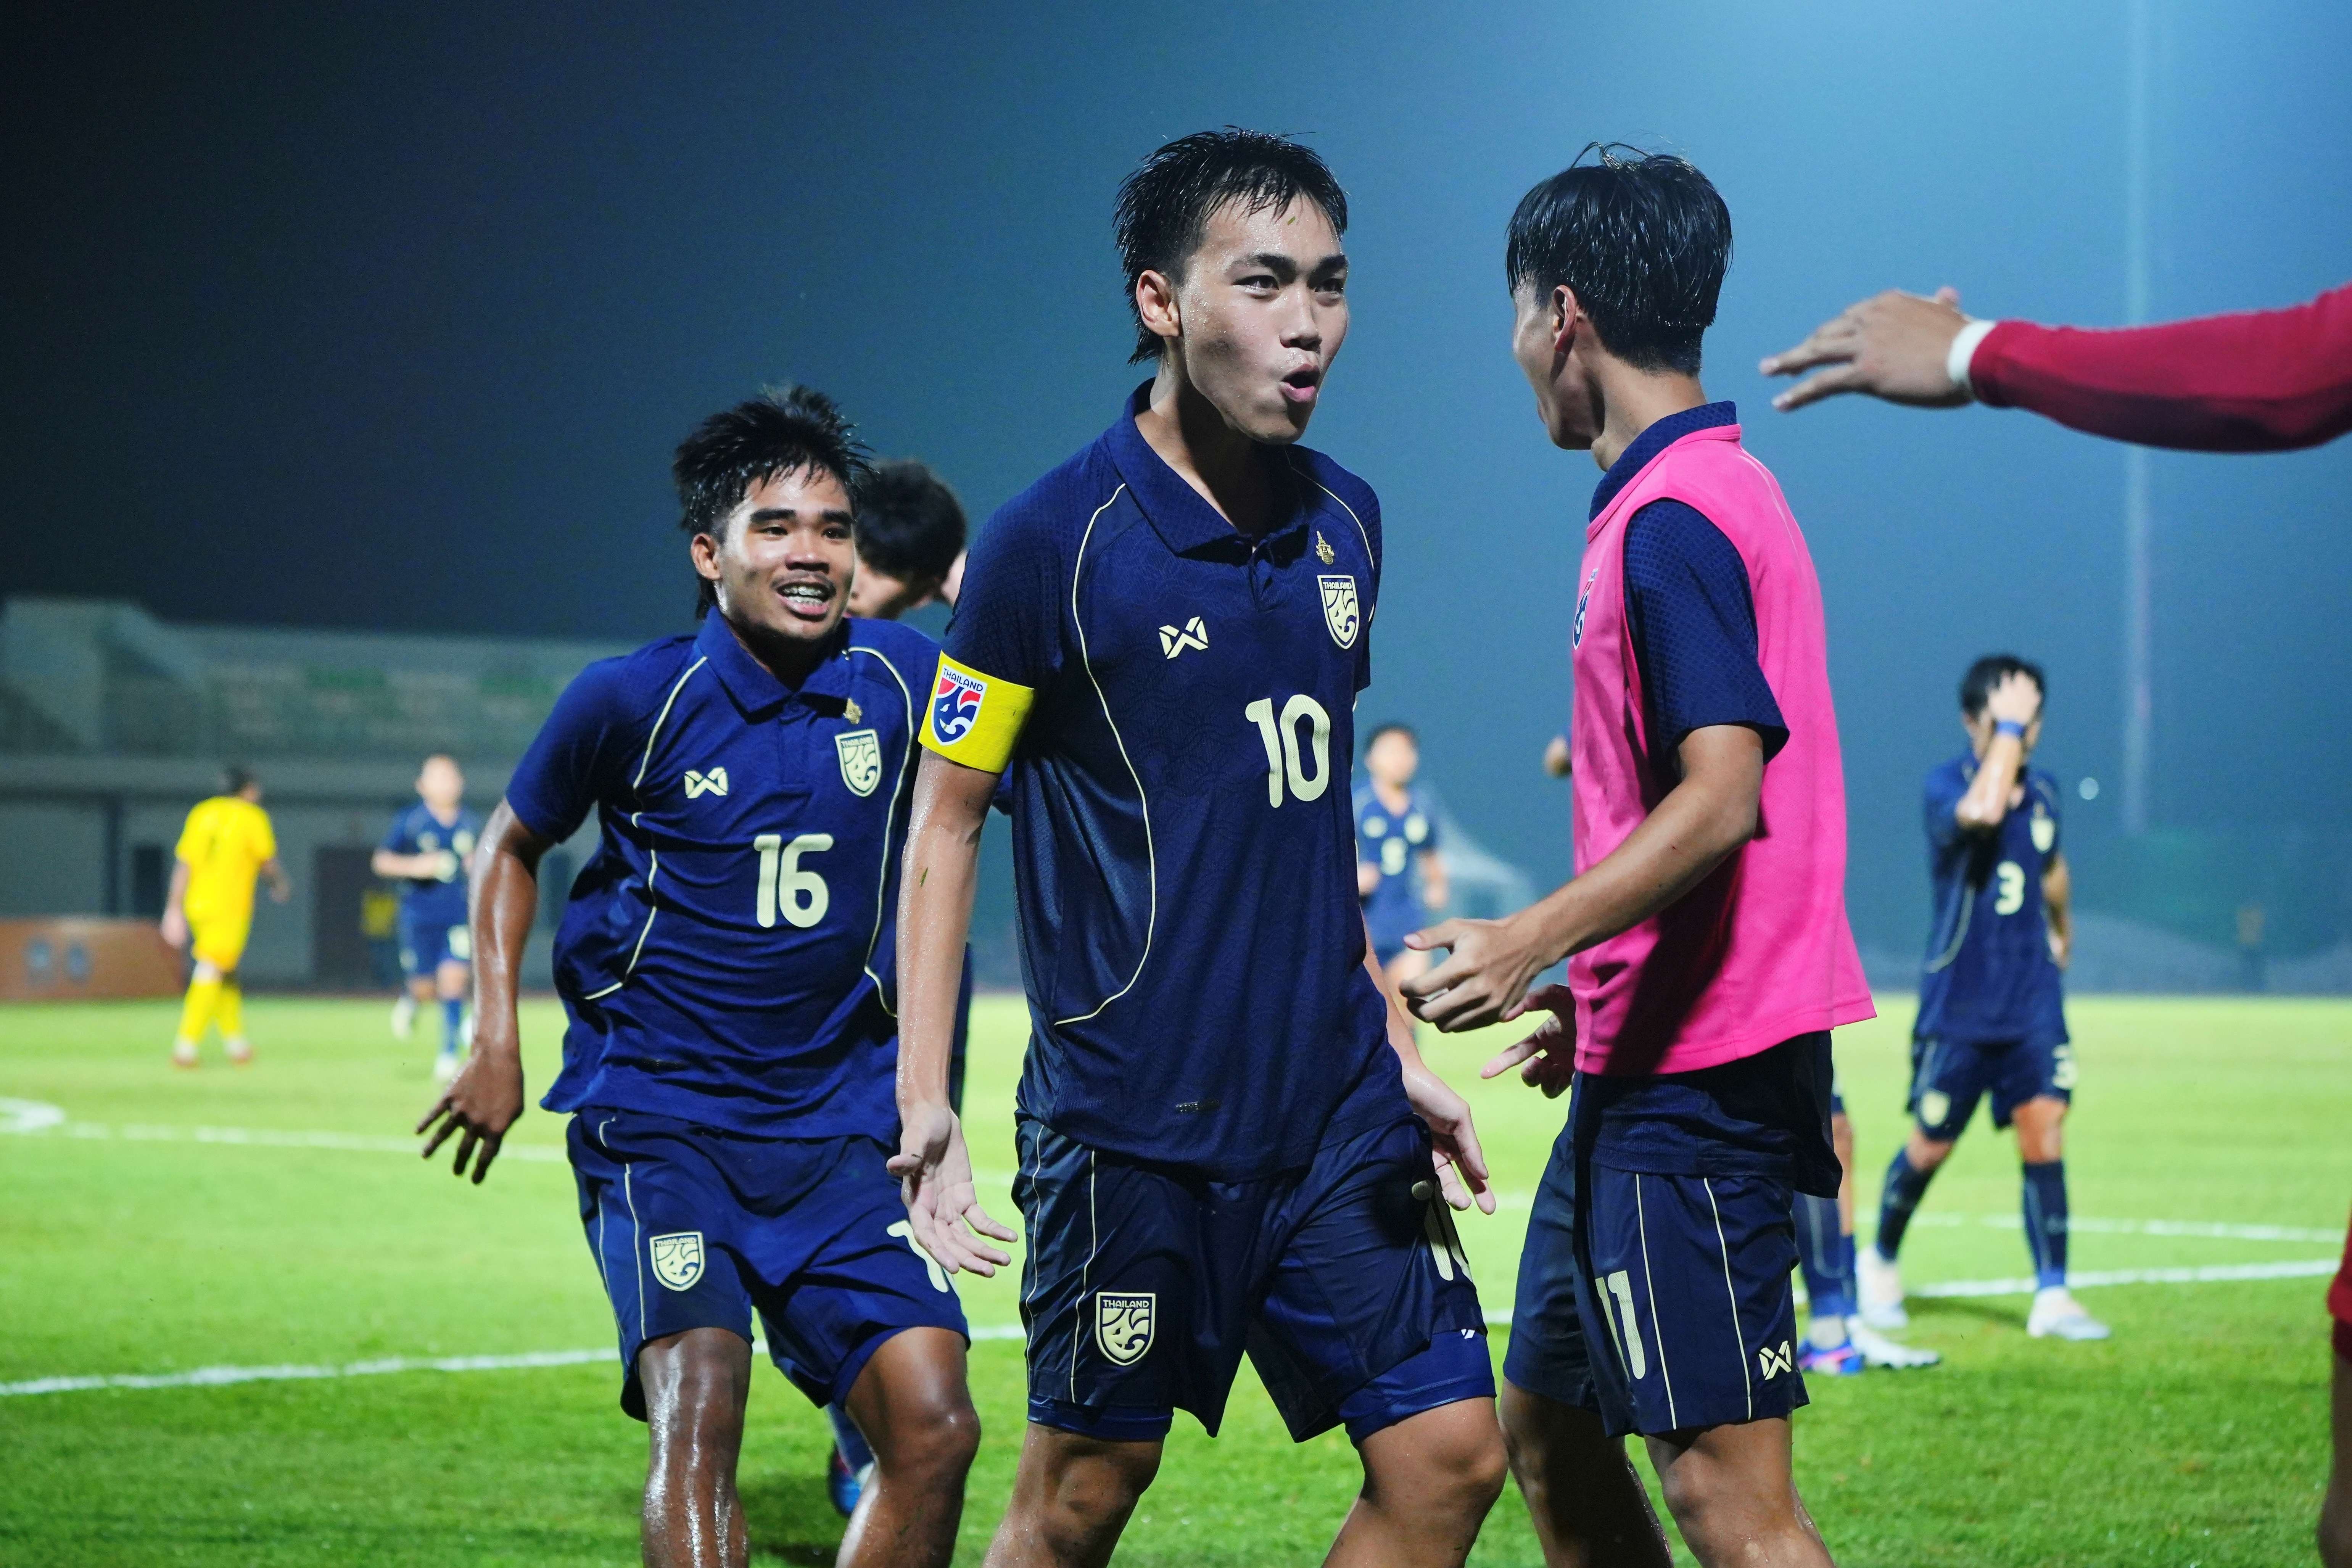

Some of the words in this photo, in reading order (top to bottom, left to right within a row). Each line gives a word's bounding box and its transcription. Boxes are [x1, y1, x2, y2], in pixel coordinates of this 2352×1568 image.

[1322, 581, 1352, 590] THAILAND
[943, 668, 984, 692] THAILAND
[1245, 694, 1331, 808] 10
[753, 833, 834, 928] 16
[1994, 860, 2026, 916] 3
[2051, 1043, 2079, 1090] 3
[655, 1236, 697, 1247] THAILAND
[886, 1219, 957, 1294] 1
[1102, 1299, 1150, 1309] THAILAND
